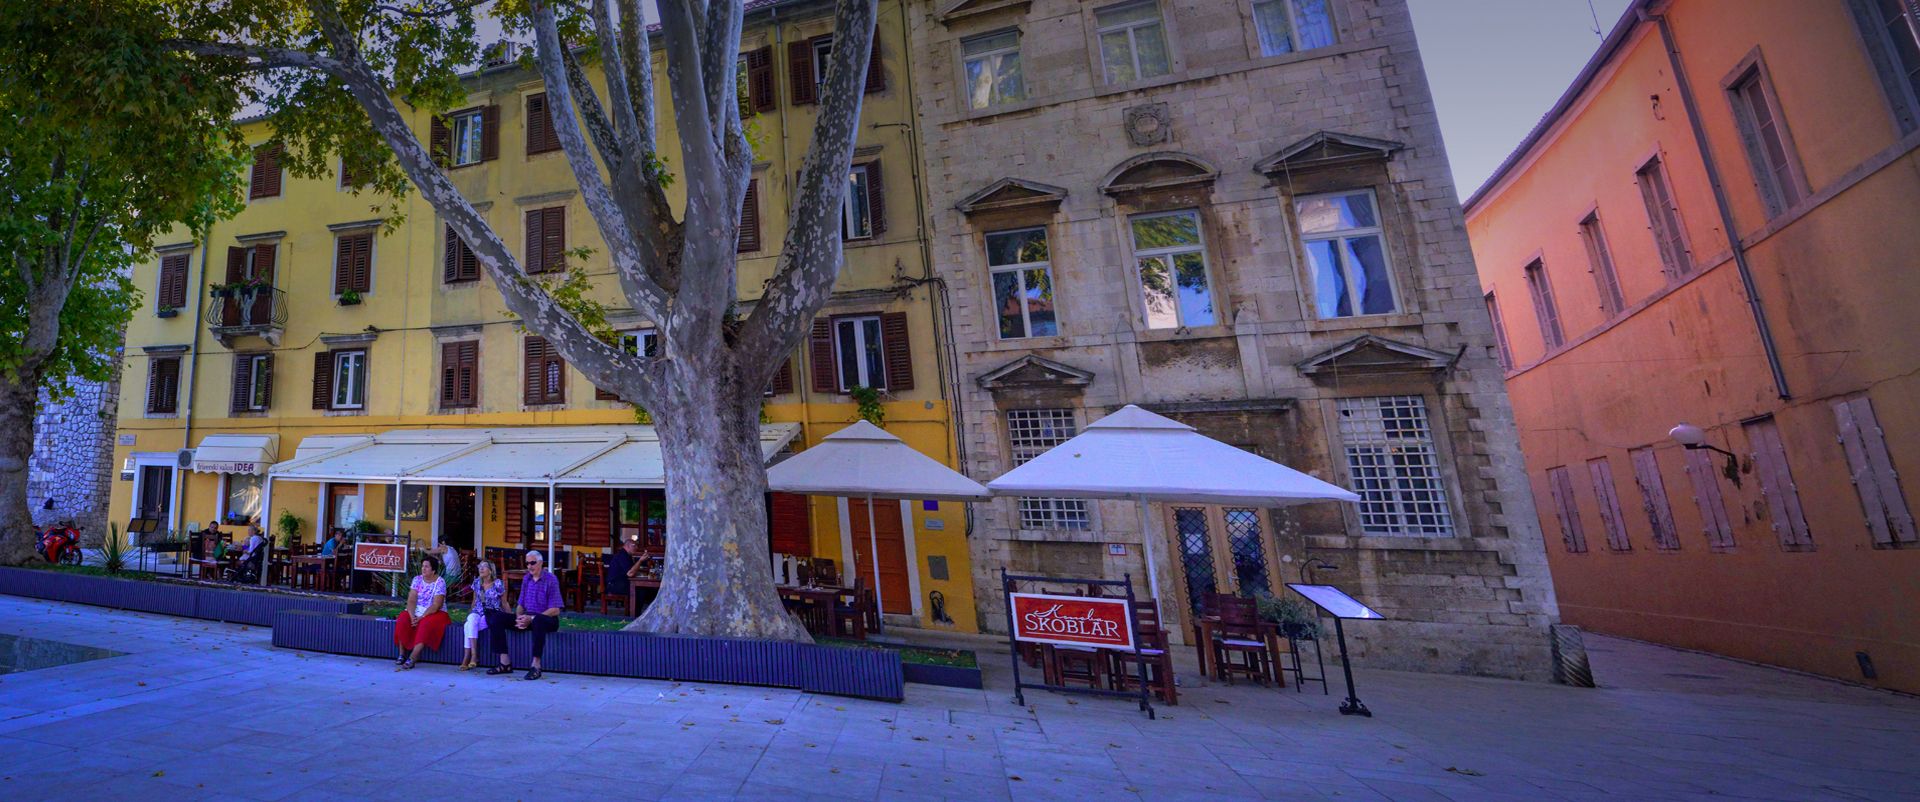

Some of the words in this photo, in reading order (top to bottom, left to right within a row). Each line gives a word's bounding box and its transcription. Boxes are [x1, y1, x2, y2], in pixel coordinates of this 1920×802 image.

[233, 463, 254, 472] IDEA
[359, 553, 401, 566] SKOBLAR
[1025, 613, 1121, 638] SKOBLAR
